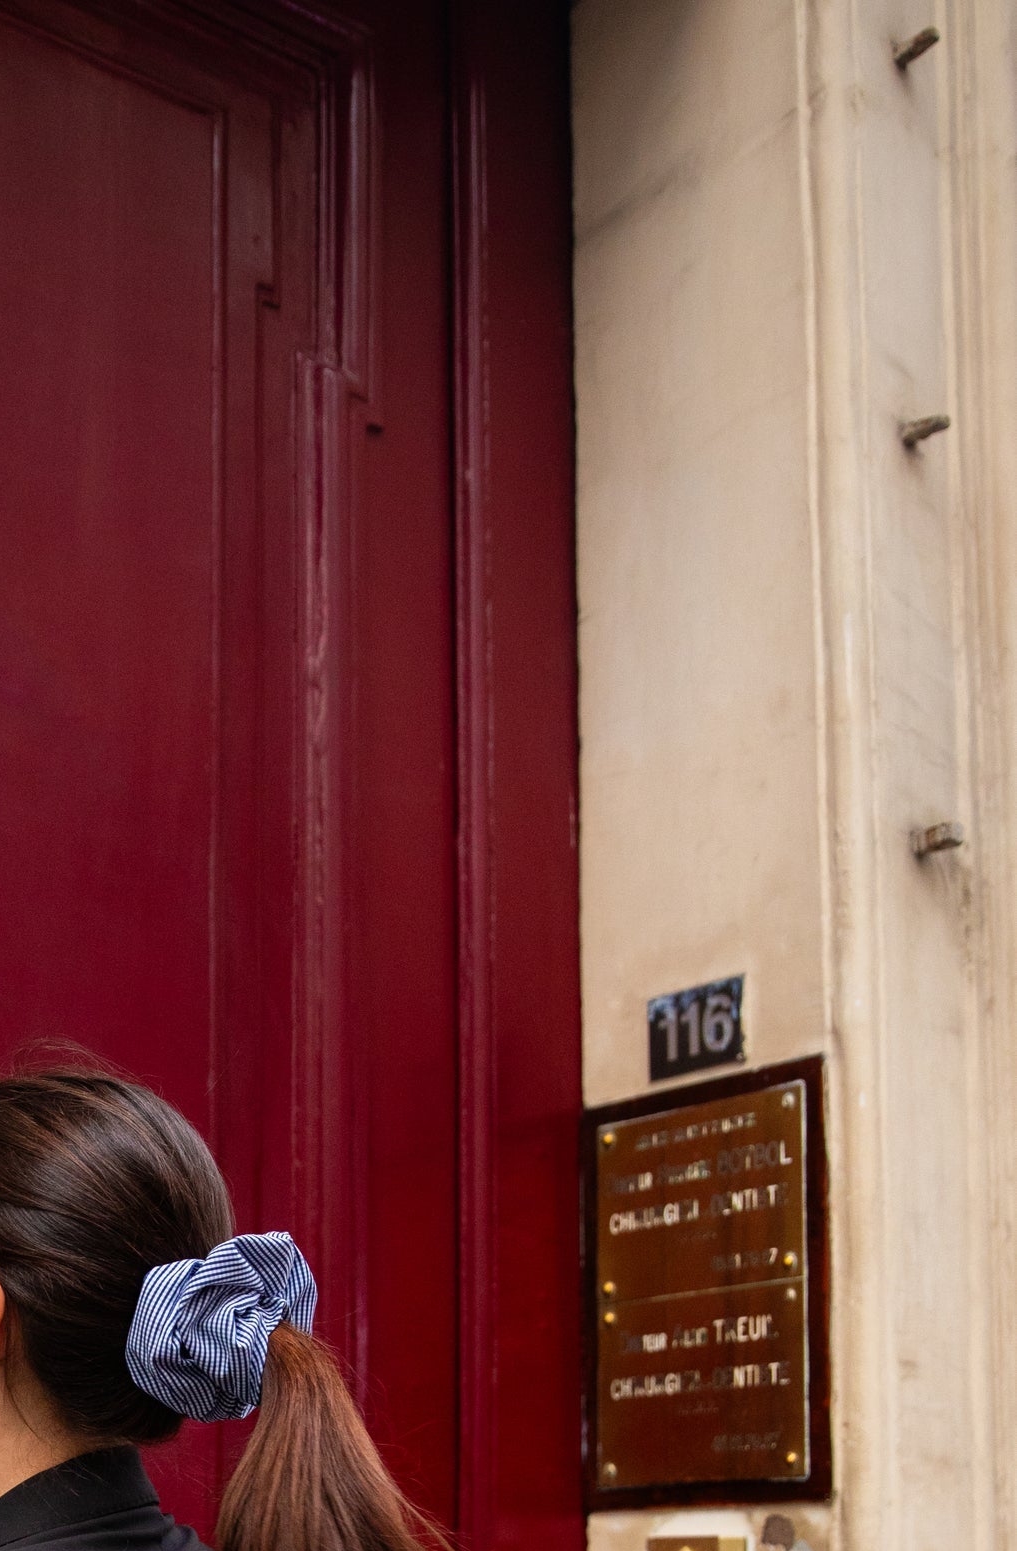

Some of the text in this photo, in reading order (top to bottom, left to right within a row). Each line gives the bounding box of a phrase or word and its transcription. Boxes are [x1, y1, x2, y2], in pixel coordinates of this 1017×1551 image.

[657, 994, 732, 1063] 116
[710, 1183, 789, 1219] DNTIT
[712, 1362, 791, 1392] DNTITE
